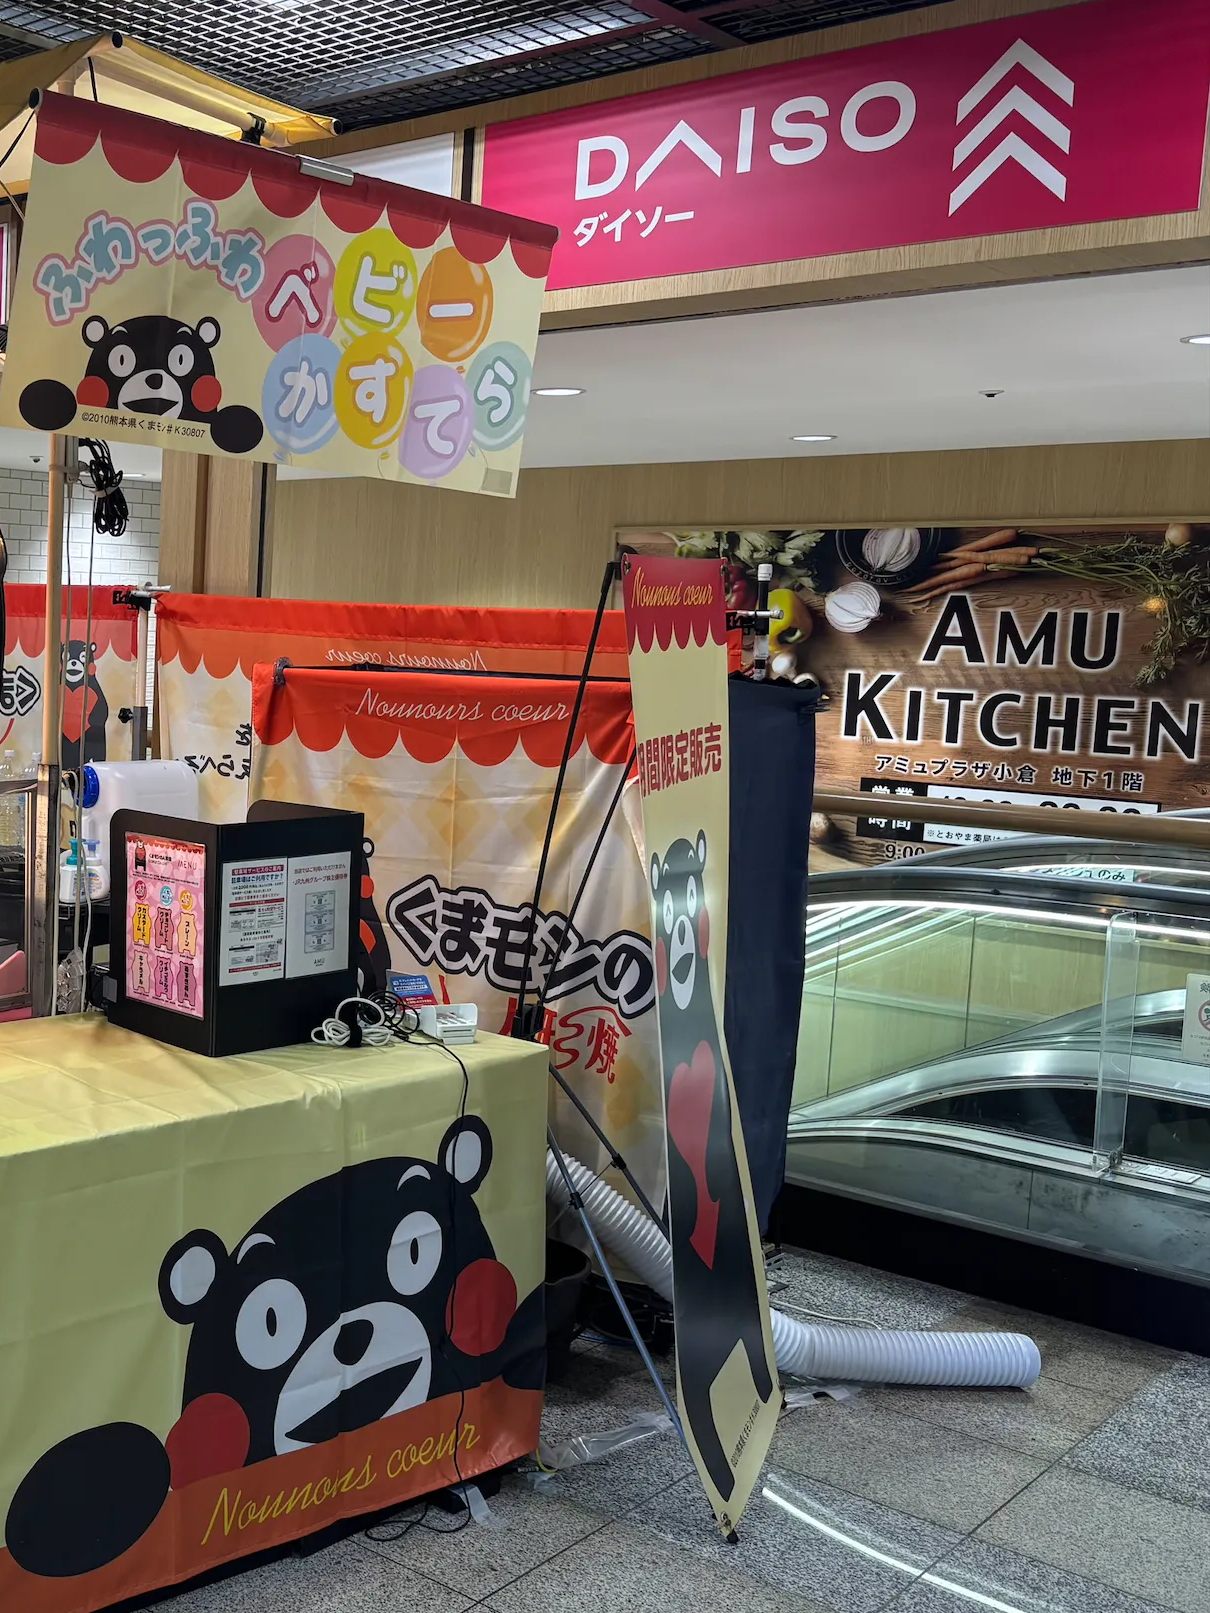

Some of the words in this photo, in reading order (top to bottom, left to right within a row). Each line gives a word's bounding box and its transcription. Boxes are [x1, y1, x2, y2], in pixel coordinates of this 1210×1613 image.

[573, 80, 916, 200] DAISO
[35, 200, 264, 325] ふわっふわ
[573, 206, 694, 248] ダイソー
[265, 254, 475, 327] ベビー
[279, 356, 518, 457] かすてら
[922, 594, 1121, 671] AMU
[355, 687, 484, 722] Nounours
[490, 703, 569, 722] coeur
[843, 672, 1200, 760] KITCHEN
[876, 754, 1037, 784] アミュプラザ小倉
[1052, 766, 1144, 792] 地下1階
[178, 860, 197, 870] MENU
[390, 879, 655, 1014] くまモンの
